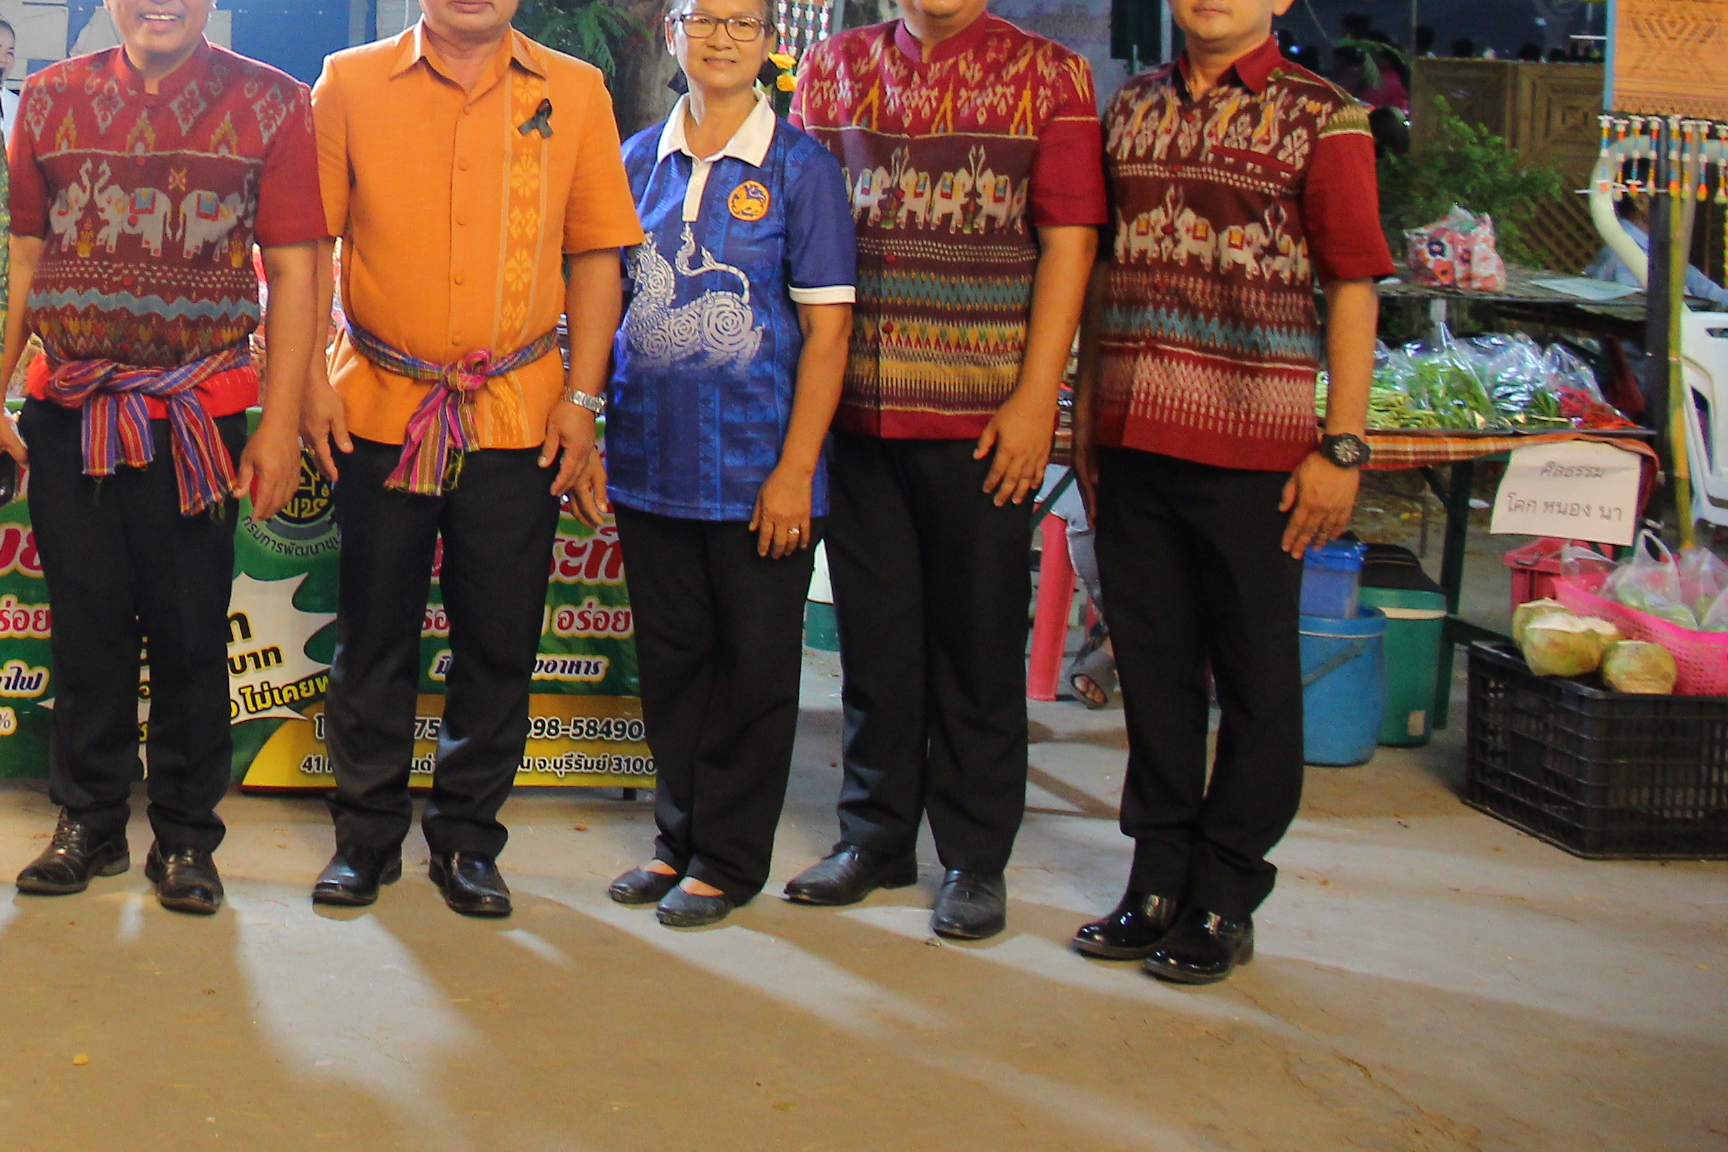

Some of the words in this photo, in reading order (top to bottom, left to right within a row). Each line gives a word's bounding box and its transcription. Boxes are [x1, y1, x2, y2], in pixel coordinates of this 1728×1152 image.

[1506, 491, 1537, 514] โคก
[1543, 501, 1591, 518] หนอง
[1599, 506, 1623, 521] นา
[557, 601, 632, 633] อร่อย
[527, 717, 644, 740] 98-58490
